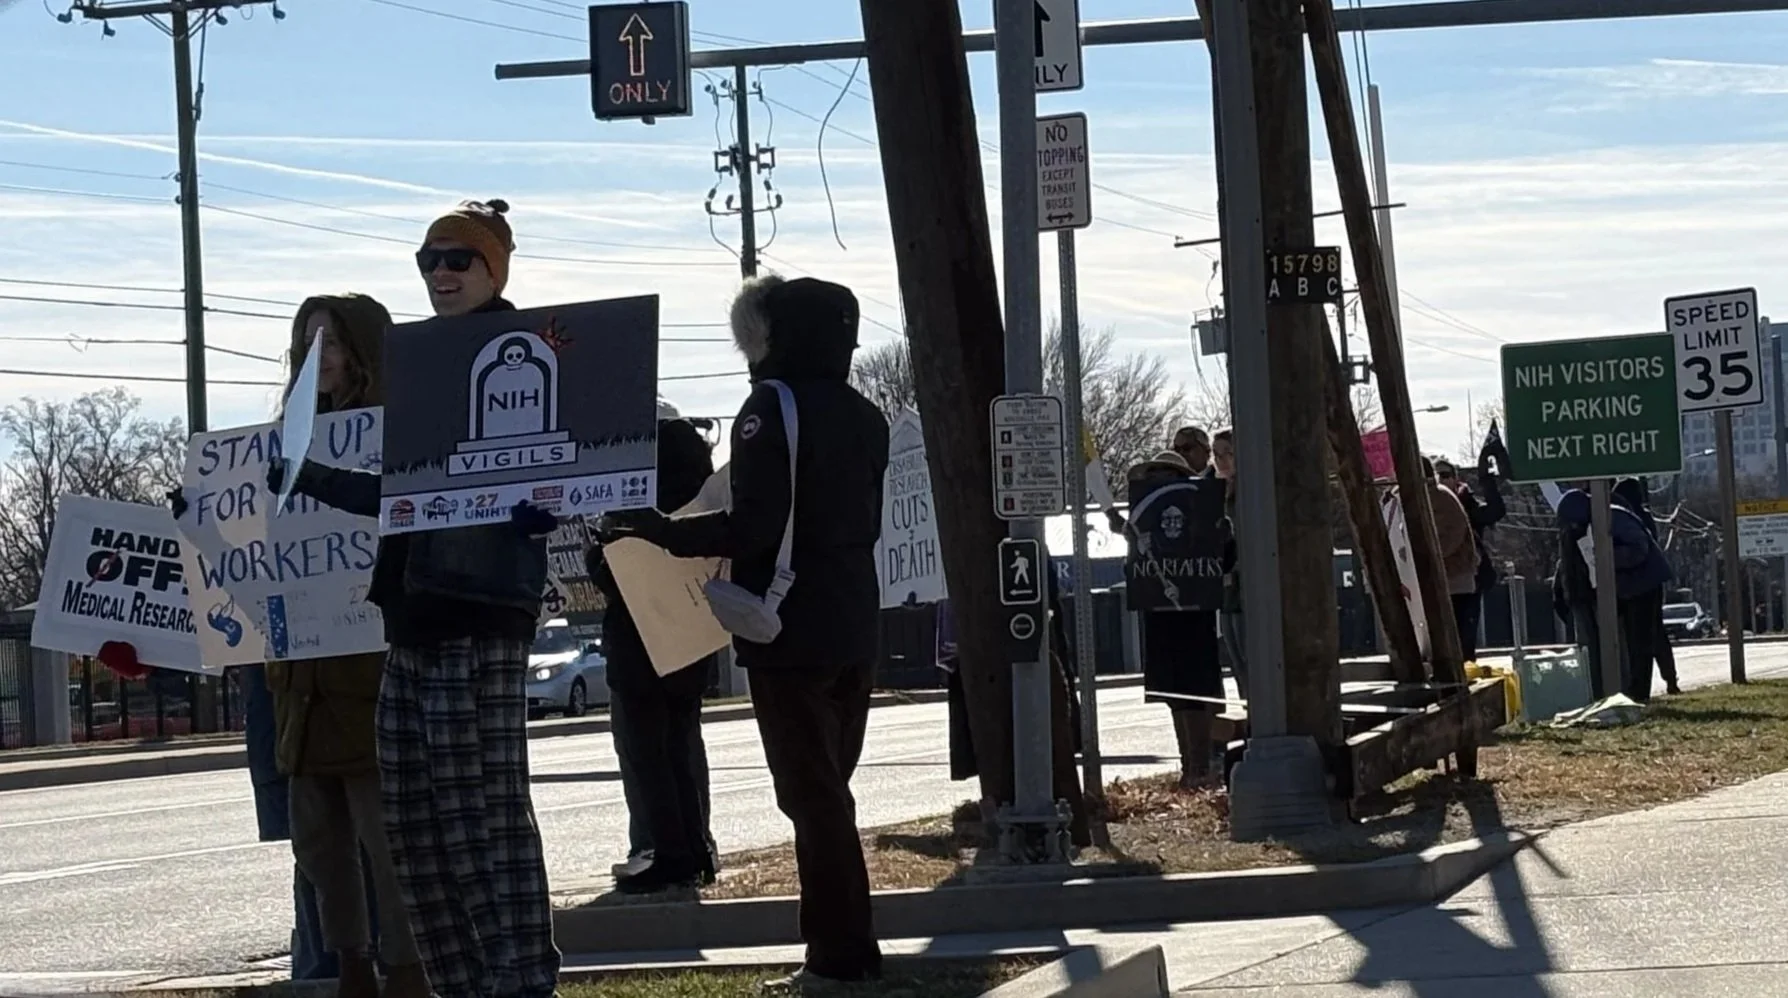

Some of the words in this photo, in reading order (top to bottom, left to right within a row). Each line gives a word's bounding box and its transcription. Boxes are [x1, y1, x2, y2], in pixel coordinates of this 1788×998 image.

[609, 80, 671, 104] ONLY
[1045, 124, 1068, 143] NO
[1037, 146, 1084, 168] TOPPING
[1042, 168, 1074, 182] EXCEPT
[1041, 182, 1076, 196] TRANSIT
[1270, 254, 1338, 274] 15798
[1268, 278, 1280, 298] A
[1297, 277, 1309, 296] B
[1326, 277, 1338, 296] C
[1674, 301, 1749, 327] SPEED
[1684, 326, 1743, 350] LIMIT
[1515, 365, 1553, 388] NIH
[1560, 356, 1665, 385] VISITORS
[1682, 351, 1754, 401] 35
[488, 388, 539, 412] NIH
[1541, 395, 1643, 422] PARKING
[197, 429, 284, 477] STAN
[329, 412, 375, 460] UP
[1527, 435, 1584, 460] NEXT
[1592, 430, 1660, 456] RIGHT
[460, 446, 565, 471] VIGILS
[197, 482, 257, 526] FOR
[475, 492, 499, 509] 27
[585, 484, 614, 501] SAFA
[464, 506, 512, 520] UNIHT
[891, 492, 928, 531] CUTS
[197, 530, 377, 590] WORKERS
[888, 538, 936, 586] DEATH
[128, 590, 198, 635] RESEARC
